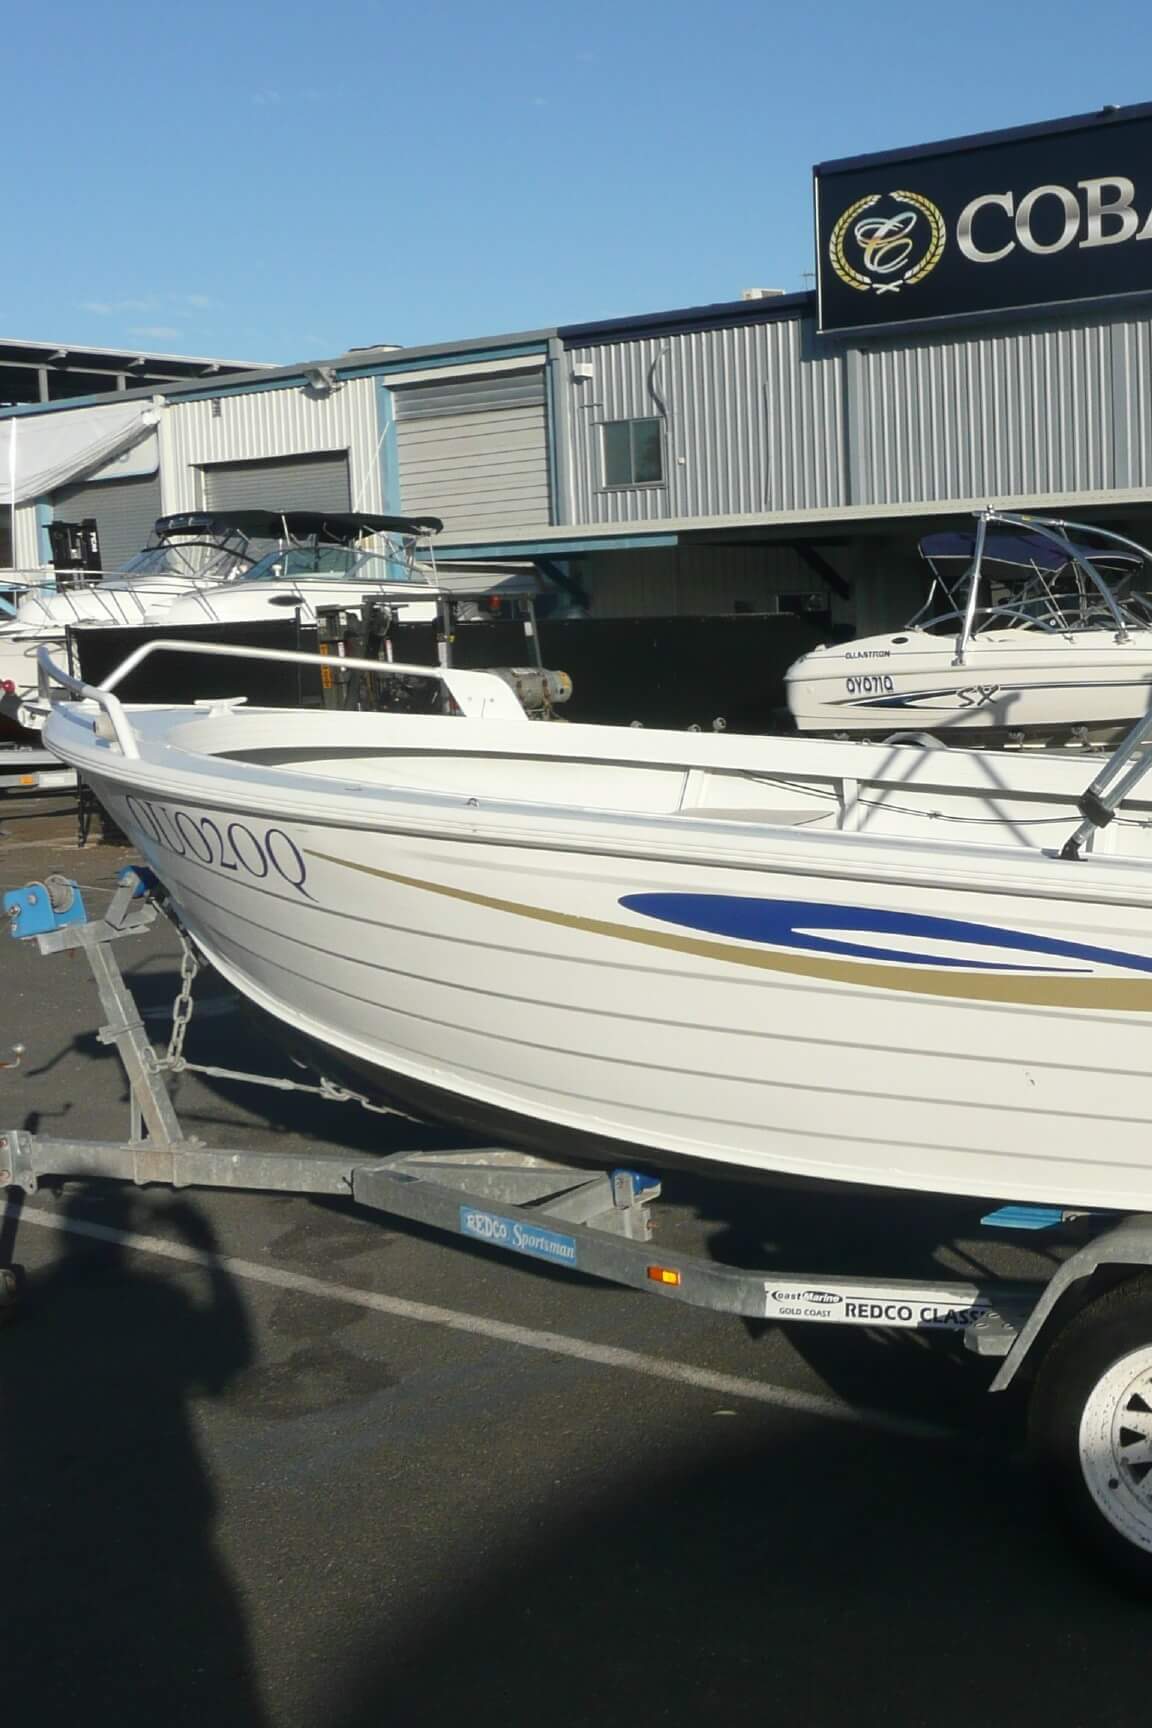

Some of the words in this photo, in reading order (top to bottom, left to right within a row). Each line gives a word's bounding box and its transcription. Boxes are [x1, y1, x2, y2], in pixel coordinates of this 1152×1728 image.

[956, 684, 999, 707] SX
[512, 1222, 575, 1259] Sportsman
[779, 1306, 802, 1316] GOLD
[804, 1308, 832, 1318] COAST
[845, 1302, 913, 1321] REDCO
